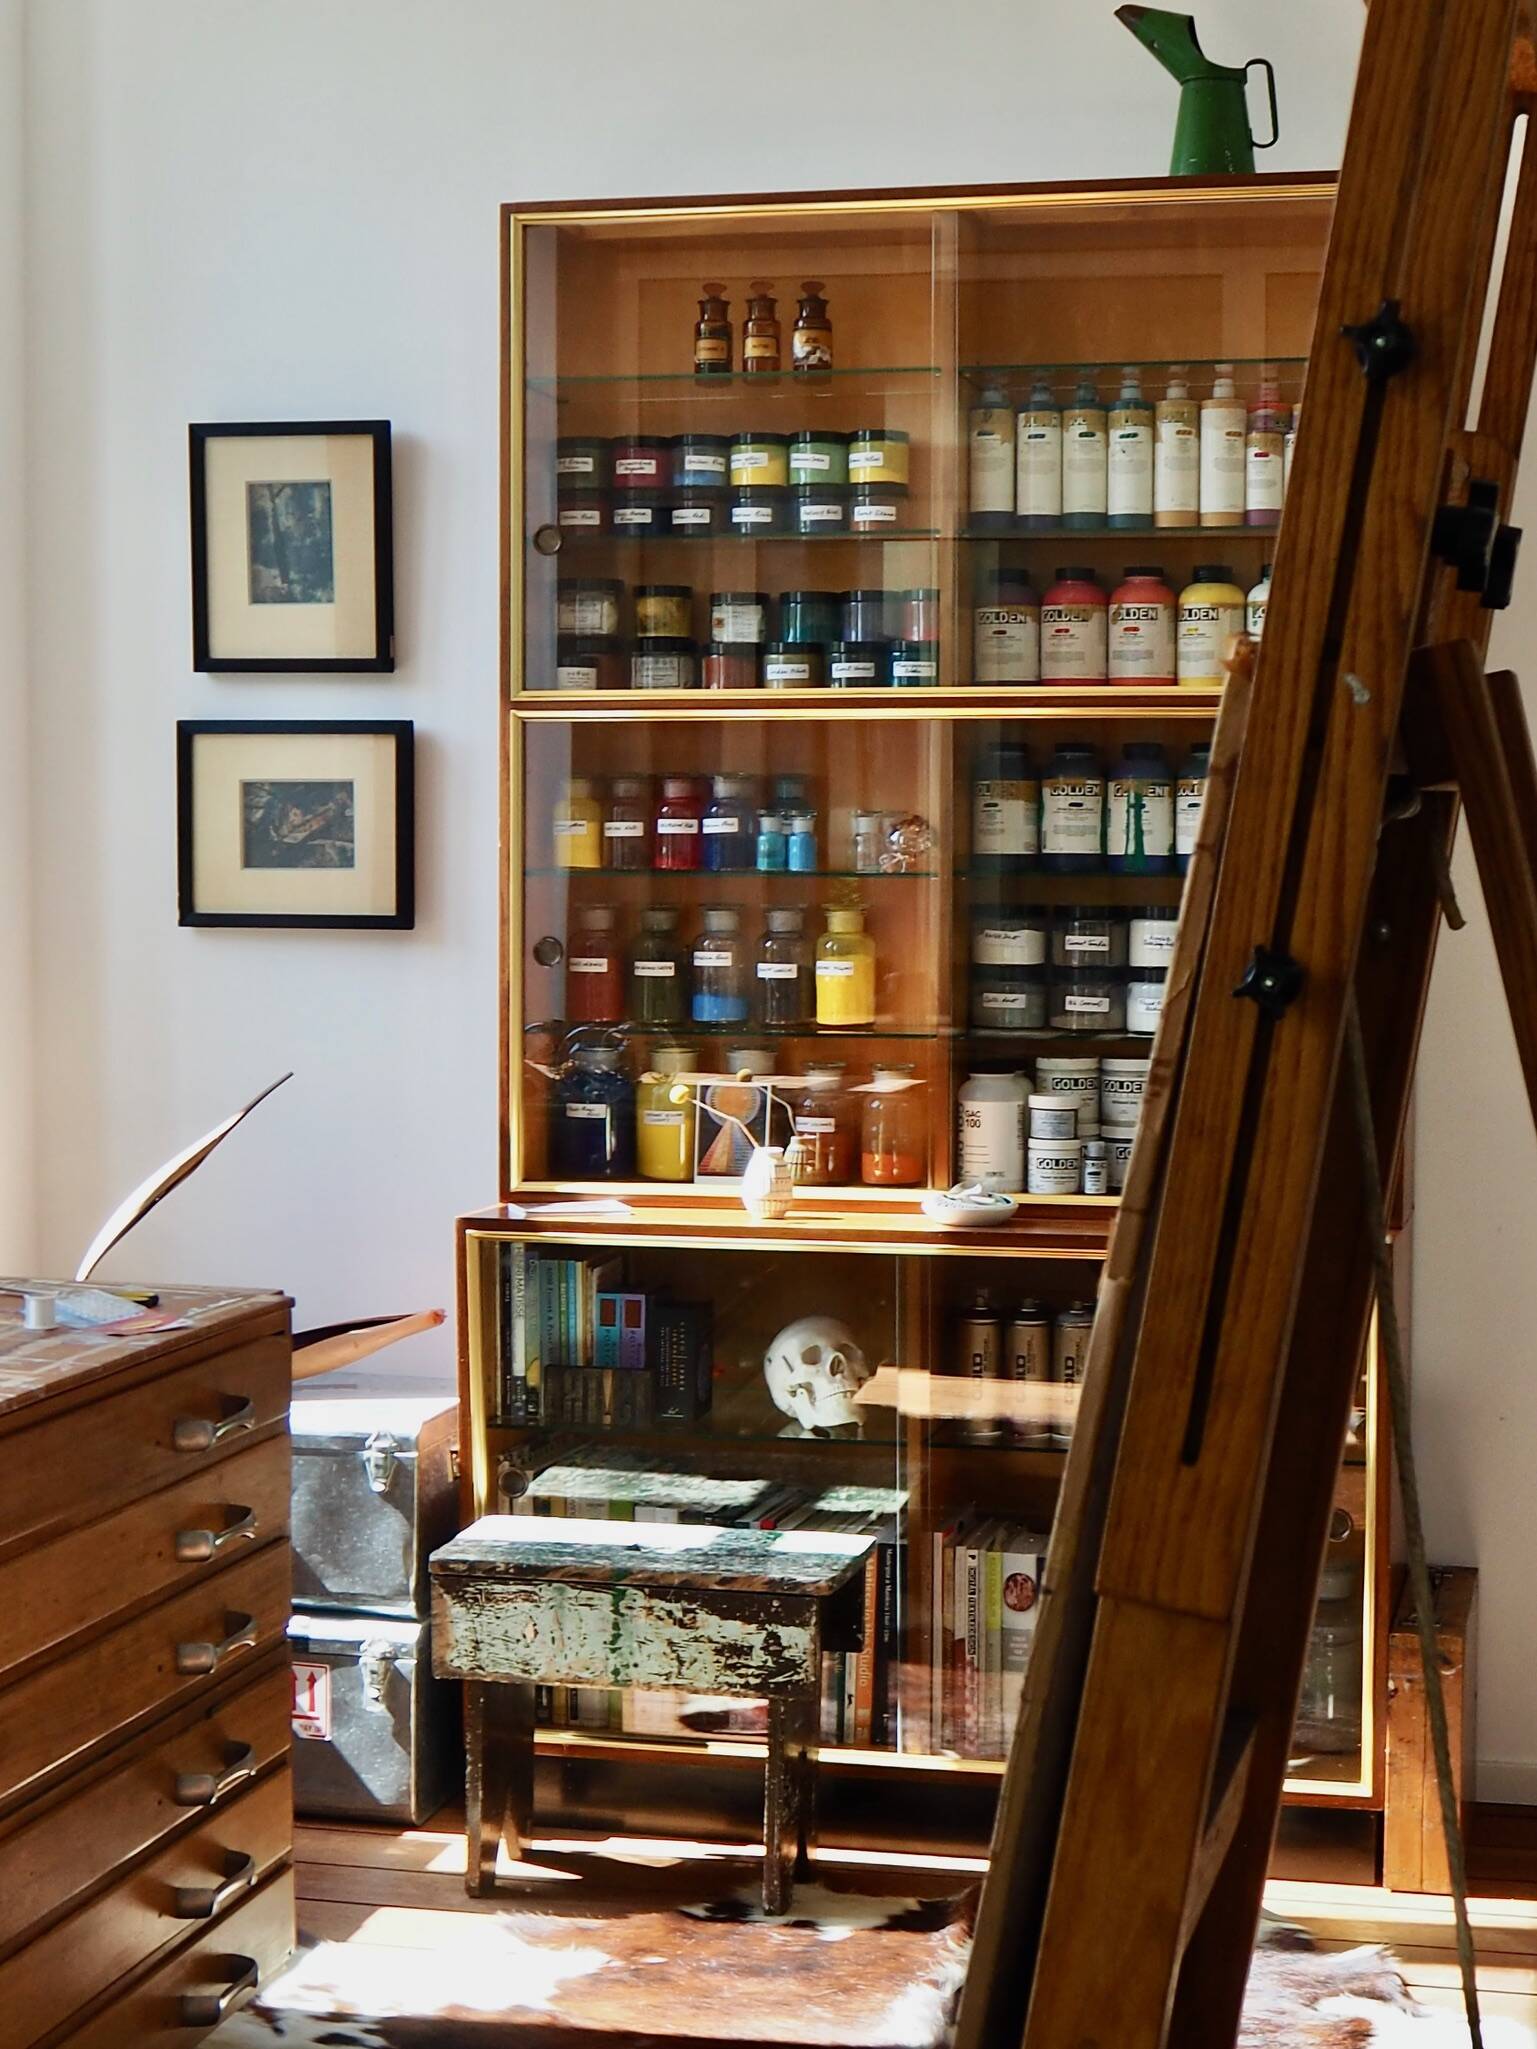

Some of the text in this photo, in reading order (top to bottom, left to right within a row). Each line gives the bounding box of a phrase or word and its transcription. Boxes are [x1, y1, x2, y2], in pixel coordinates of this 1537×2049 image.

[1102, 1080, 1143, 1093] GOLDE
[965, 1119, 981, 1128] 100
[860, 1647, 872, 1687] Studio
